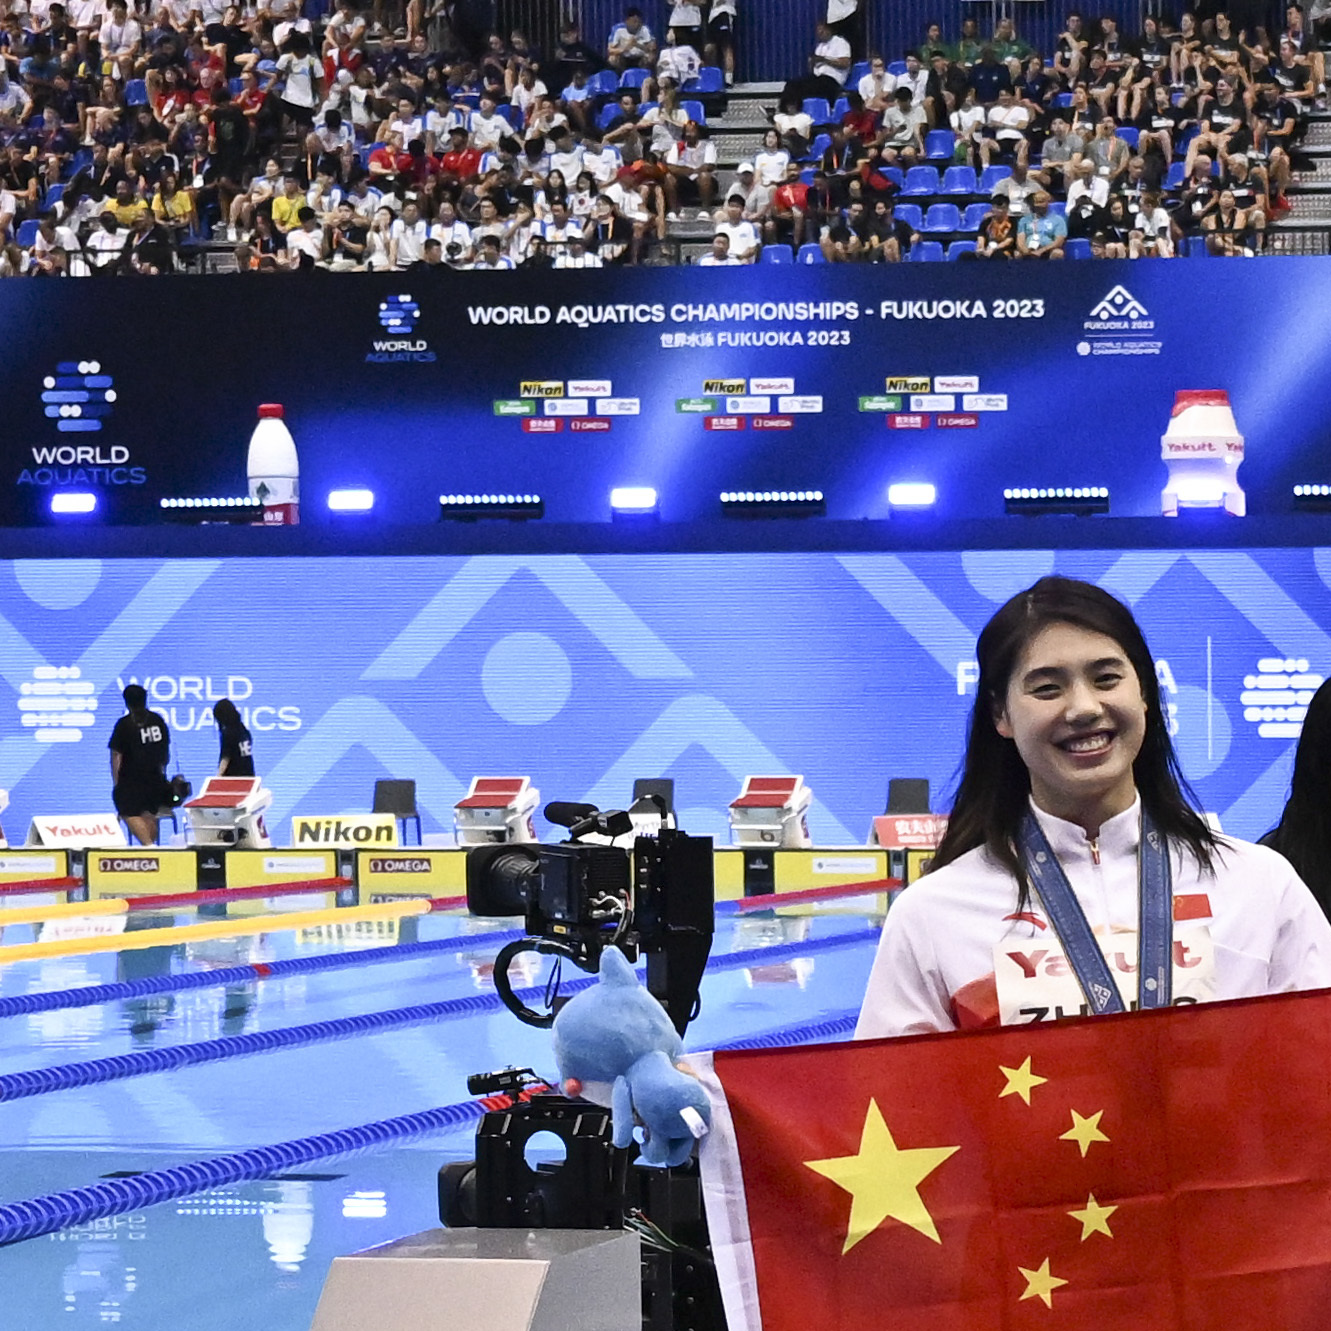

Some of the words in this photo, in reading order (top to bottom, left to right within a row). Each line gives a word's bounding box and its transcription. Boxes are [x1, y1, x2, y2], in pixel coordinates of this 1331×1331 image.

[468, 305, 550, 325] WORLD
[556, 304, 665, 328] AQUATICS
[670, 302, 859, 322] CHAMPIONSHIPS
[881, 300, 988, 320] FUKUOKA
[992, 299, 1045, 318] 2023
[372, 340, 428, 351] WORLD
[717, 332, 804, 348] FUKUOKA
[807, 331, 851, 346] 2023
[521, 384, 563, 396] Nikon
[704, 381, 746, 394] Nikon
[887, 380, 929, 392] Nikon
[1167, 442, 1217, 453] Yakult
[32, 446, 130, 465] WORLD
[16, 467, 147, 486] AQUATICS
[140, 725, 162, 744] HB
[45, 823, 116, 838] Yakult
[298, 820, 394, 843] Nikon
[113, 859, 159, 872] OMEGA
[384, 859, 431, 871] OMEGA
